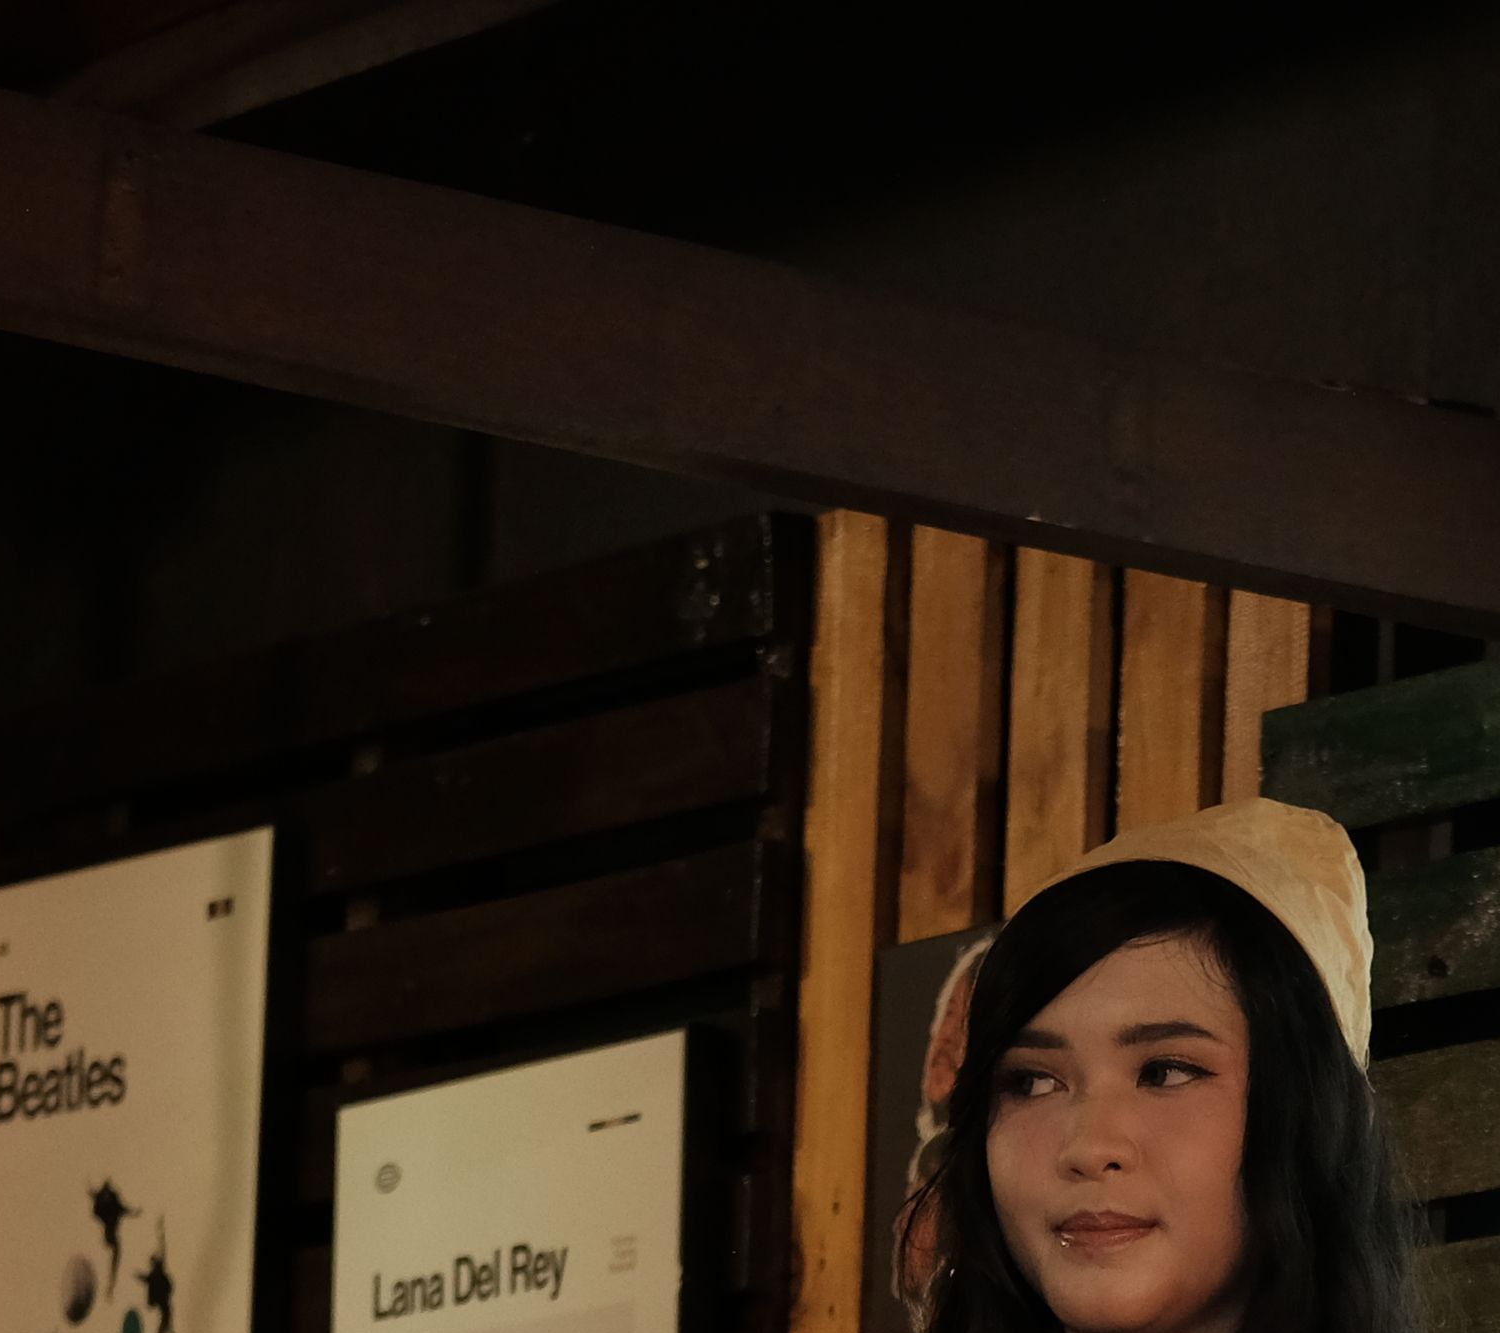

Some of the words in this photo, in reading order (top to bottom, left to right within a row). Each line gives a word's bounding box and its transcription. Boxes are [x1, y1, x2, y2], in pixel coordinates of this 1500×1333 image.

[371, 1269, 446, 1323] Lana
[451, 1248, 502, 1308] Del
[509, 1243, 570, 1302] Rey
